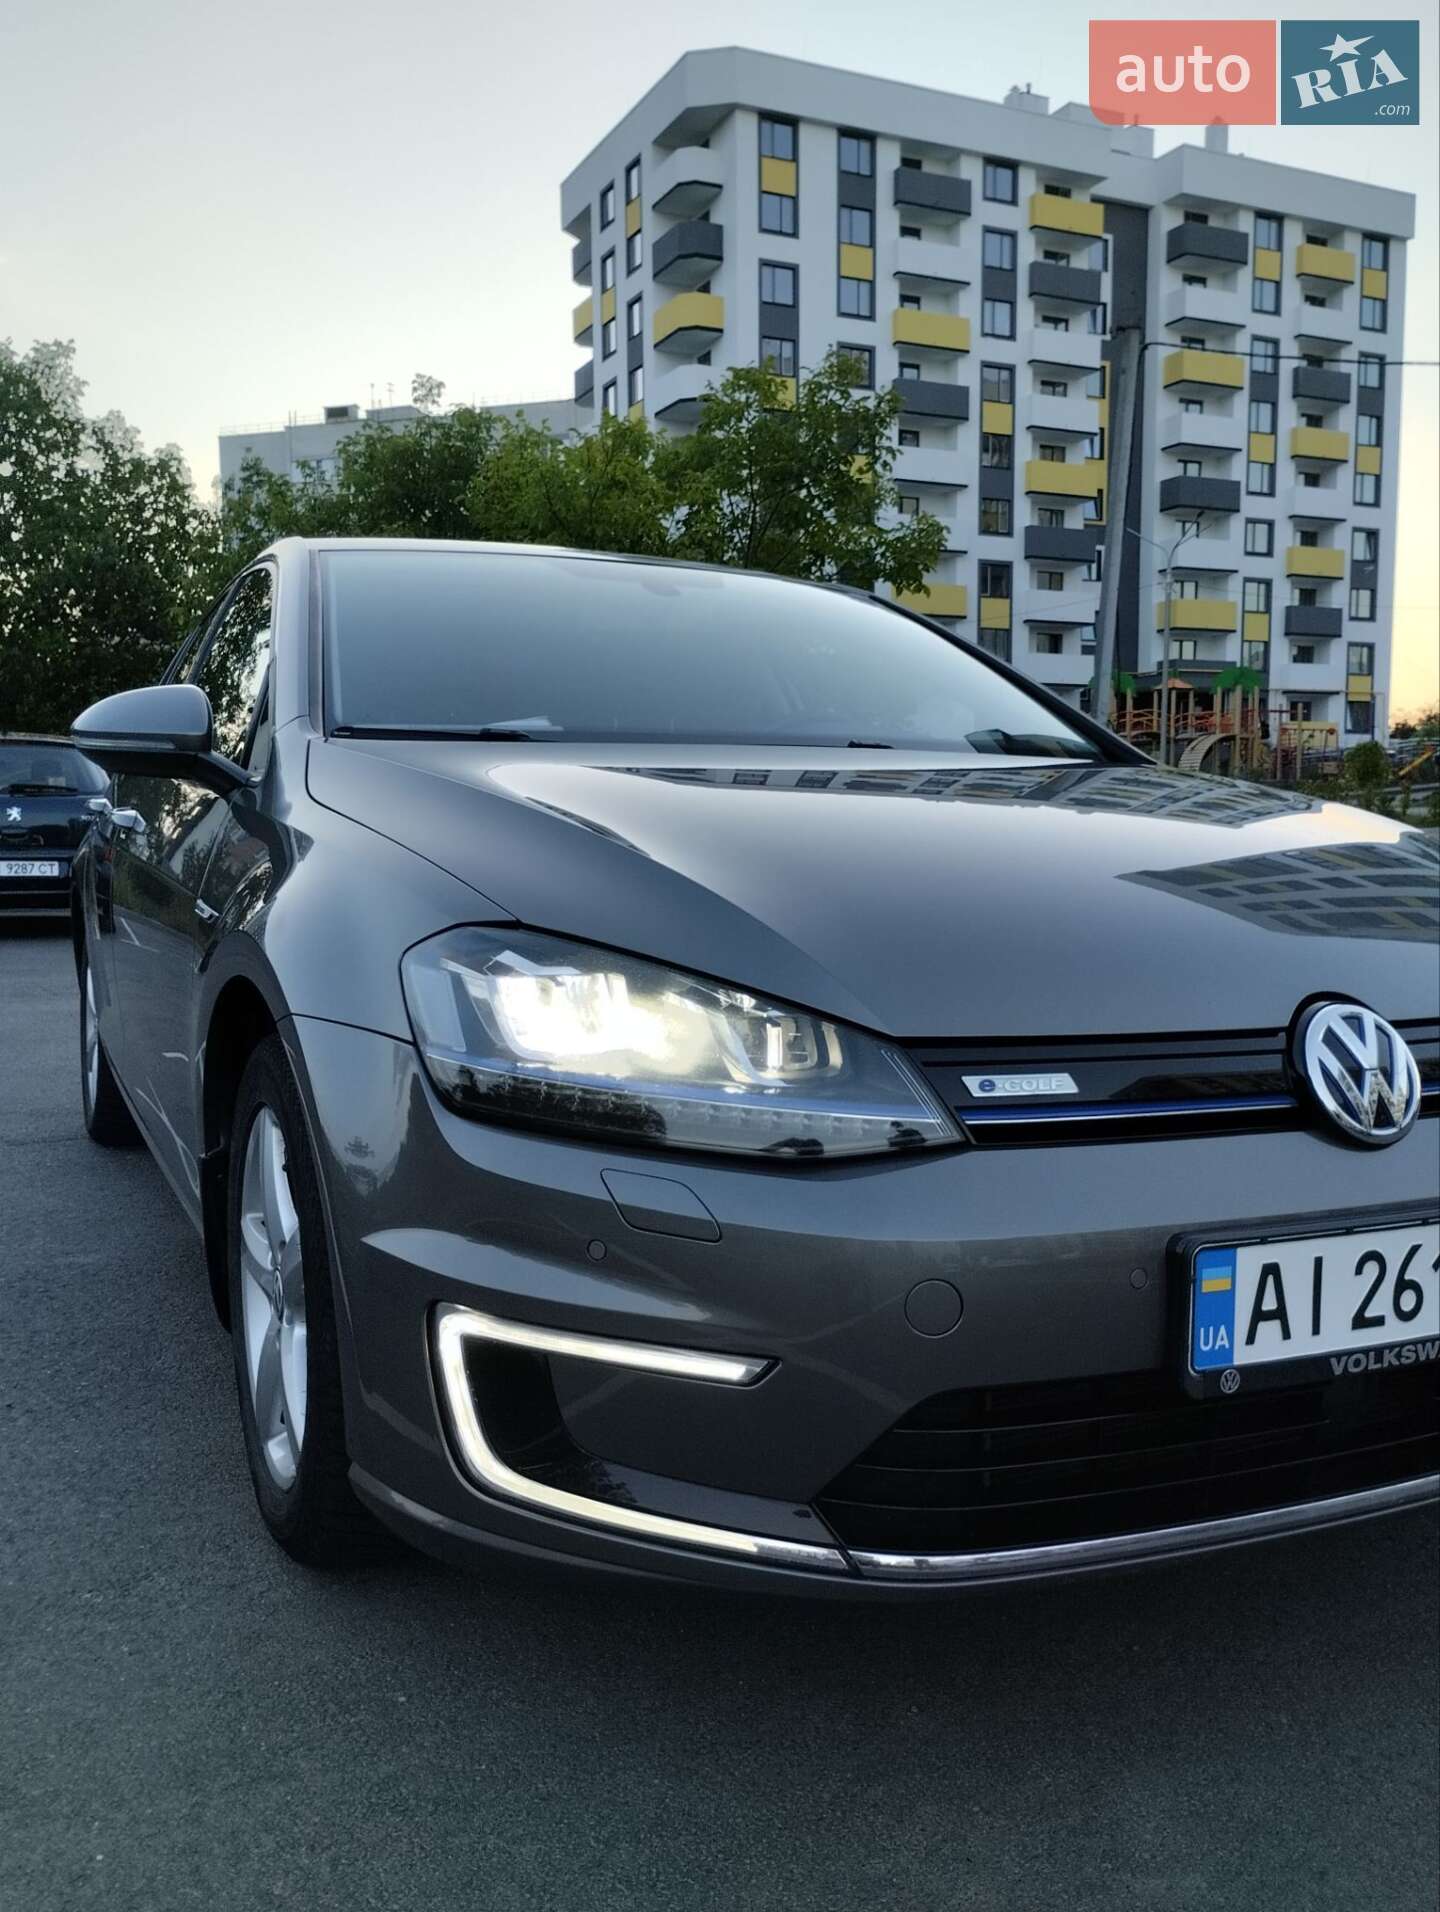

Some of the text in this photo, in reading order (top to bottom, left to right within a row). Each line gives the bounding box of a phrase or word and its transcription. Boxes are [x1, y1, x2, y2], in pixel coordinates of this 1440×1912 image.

[6, 863, 56, 875] 9287 CT
[1245, 1255, 1323, 1345] AI
[1200, 1325, 1230, 1351] UA
[1329, 1341, 1439, 1376] VOLKSW
